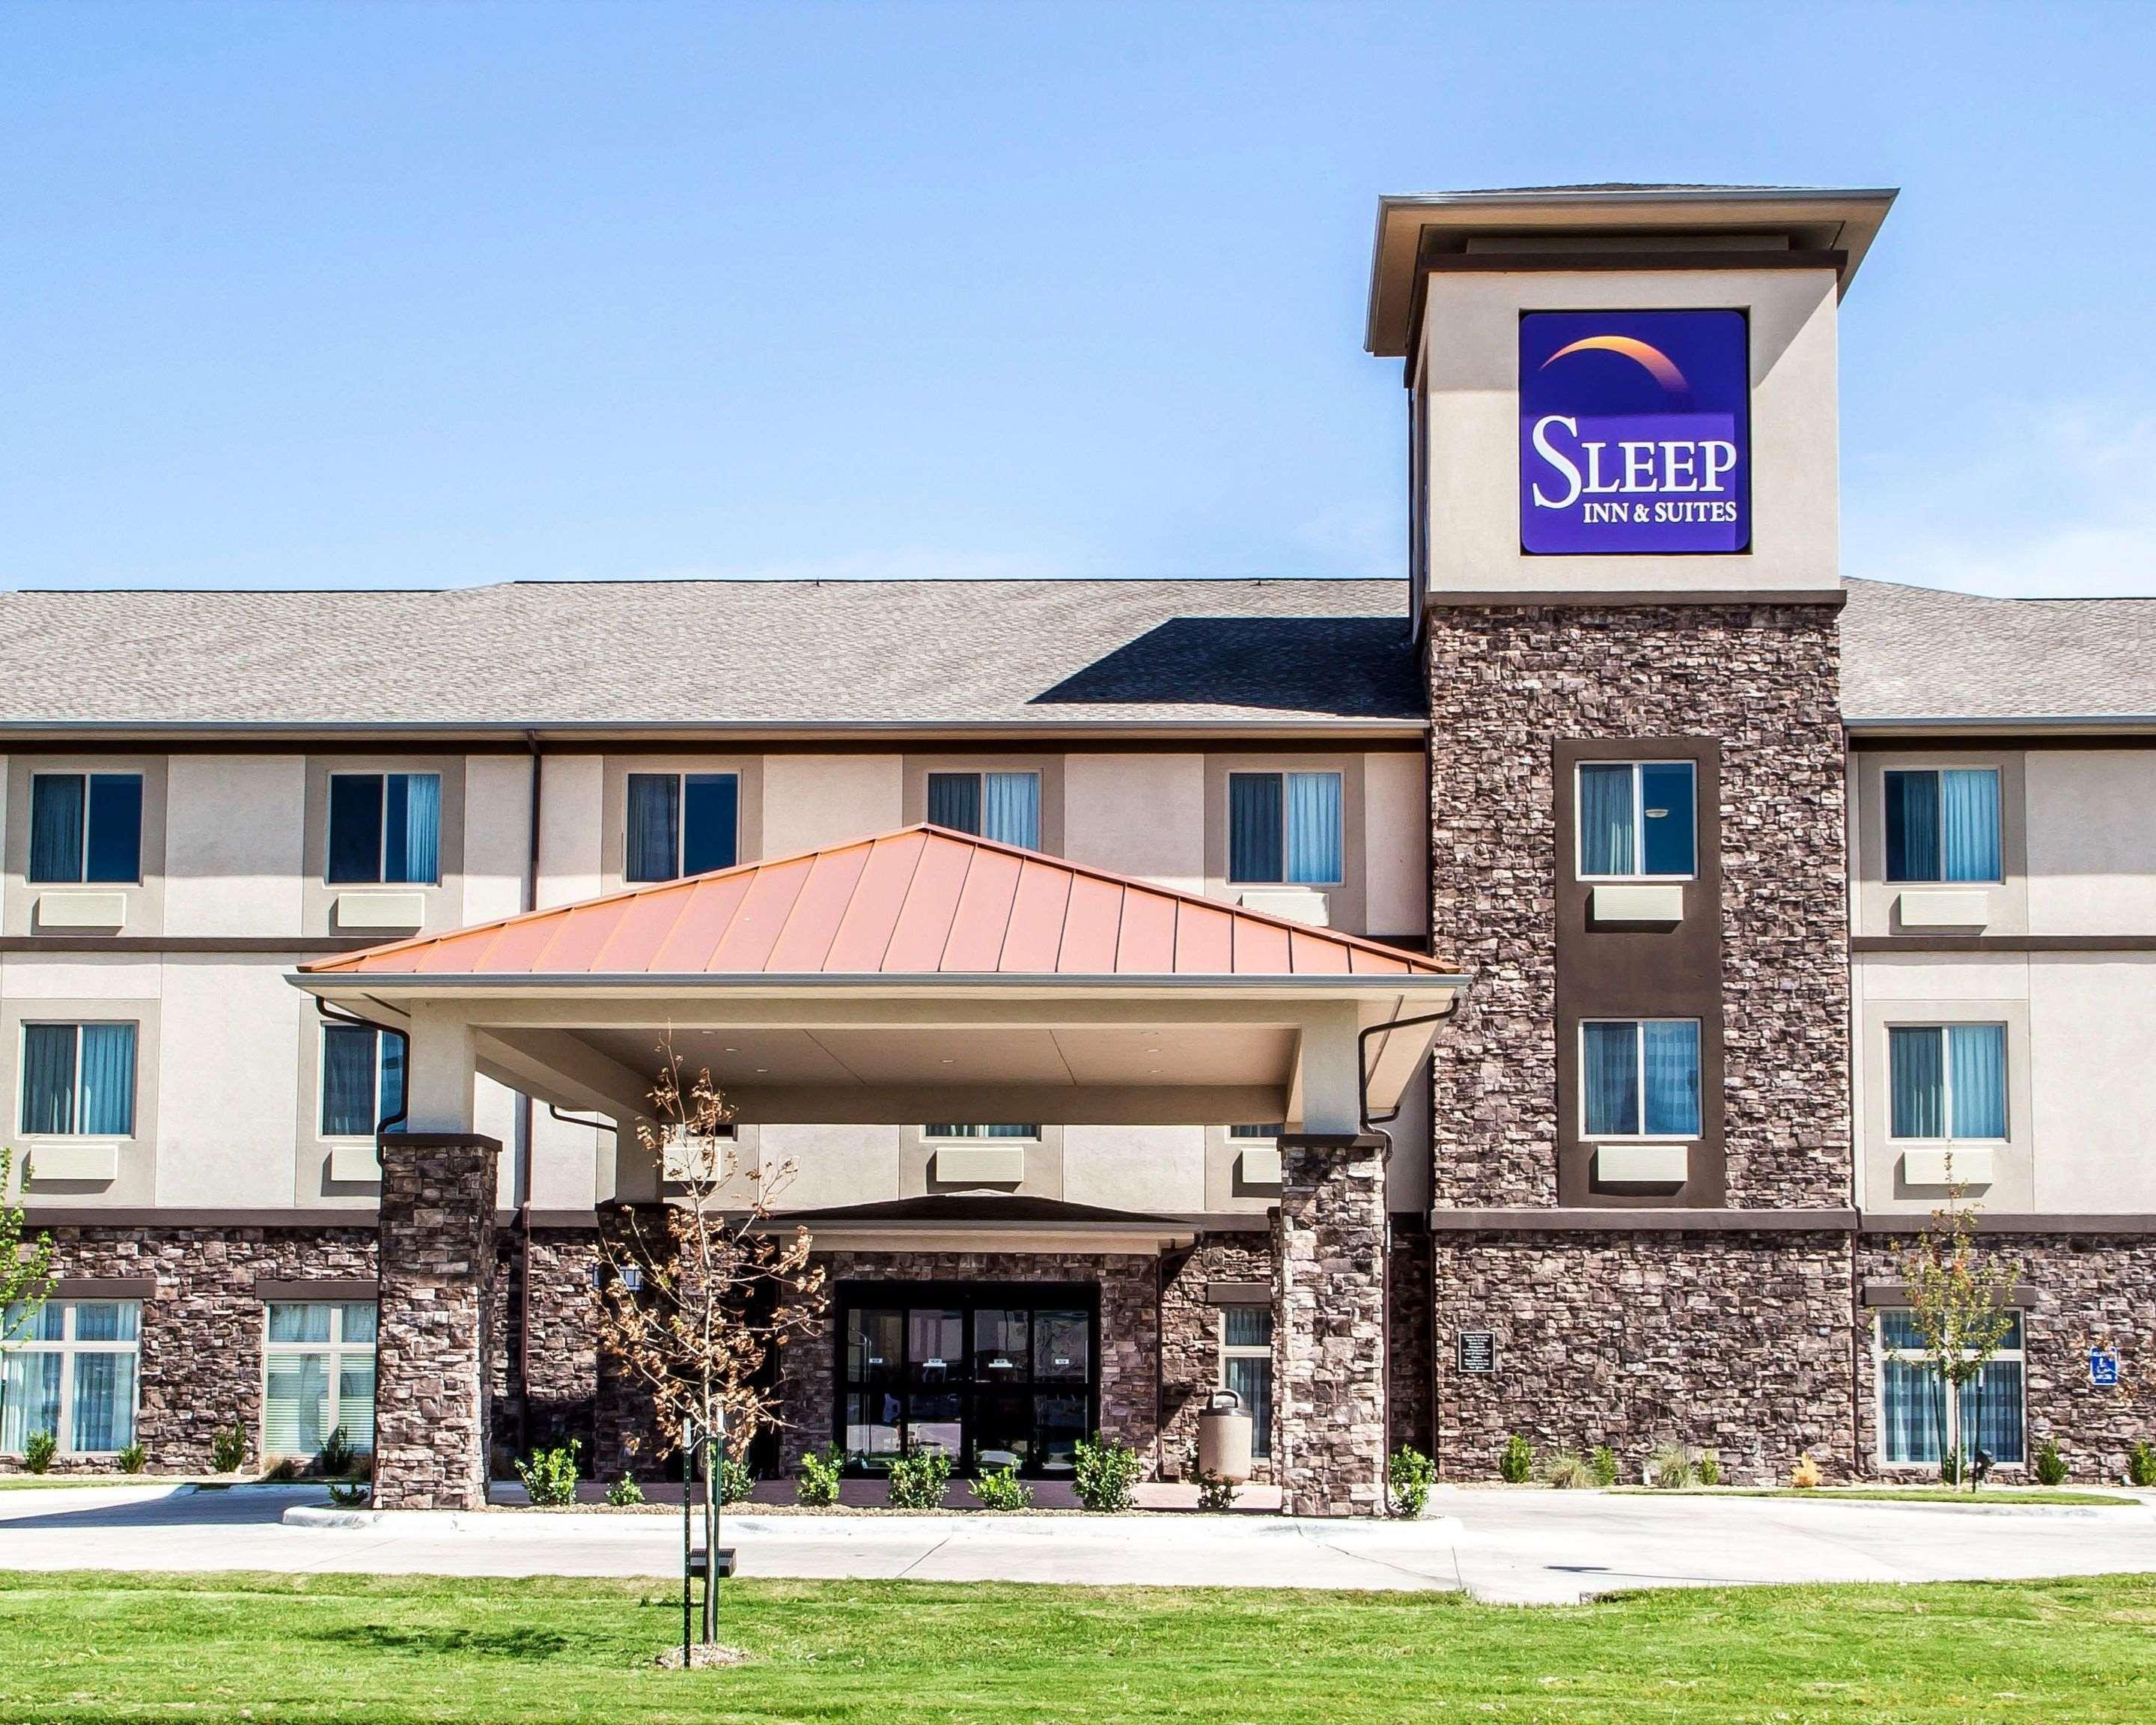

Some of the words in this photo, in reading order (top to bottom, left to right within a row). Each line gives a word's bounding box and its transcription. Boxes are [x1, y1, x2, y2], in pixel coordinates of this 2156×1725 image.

[1532, 415, 1737, 509] SLEEP
[1583, 502, 1630, 523] INN
[1633, 503, 1650, 523] &
[1654, 501, 1737, 523] SUITES
